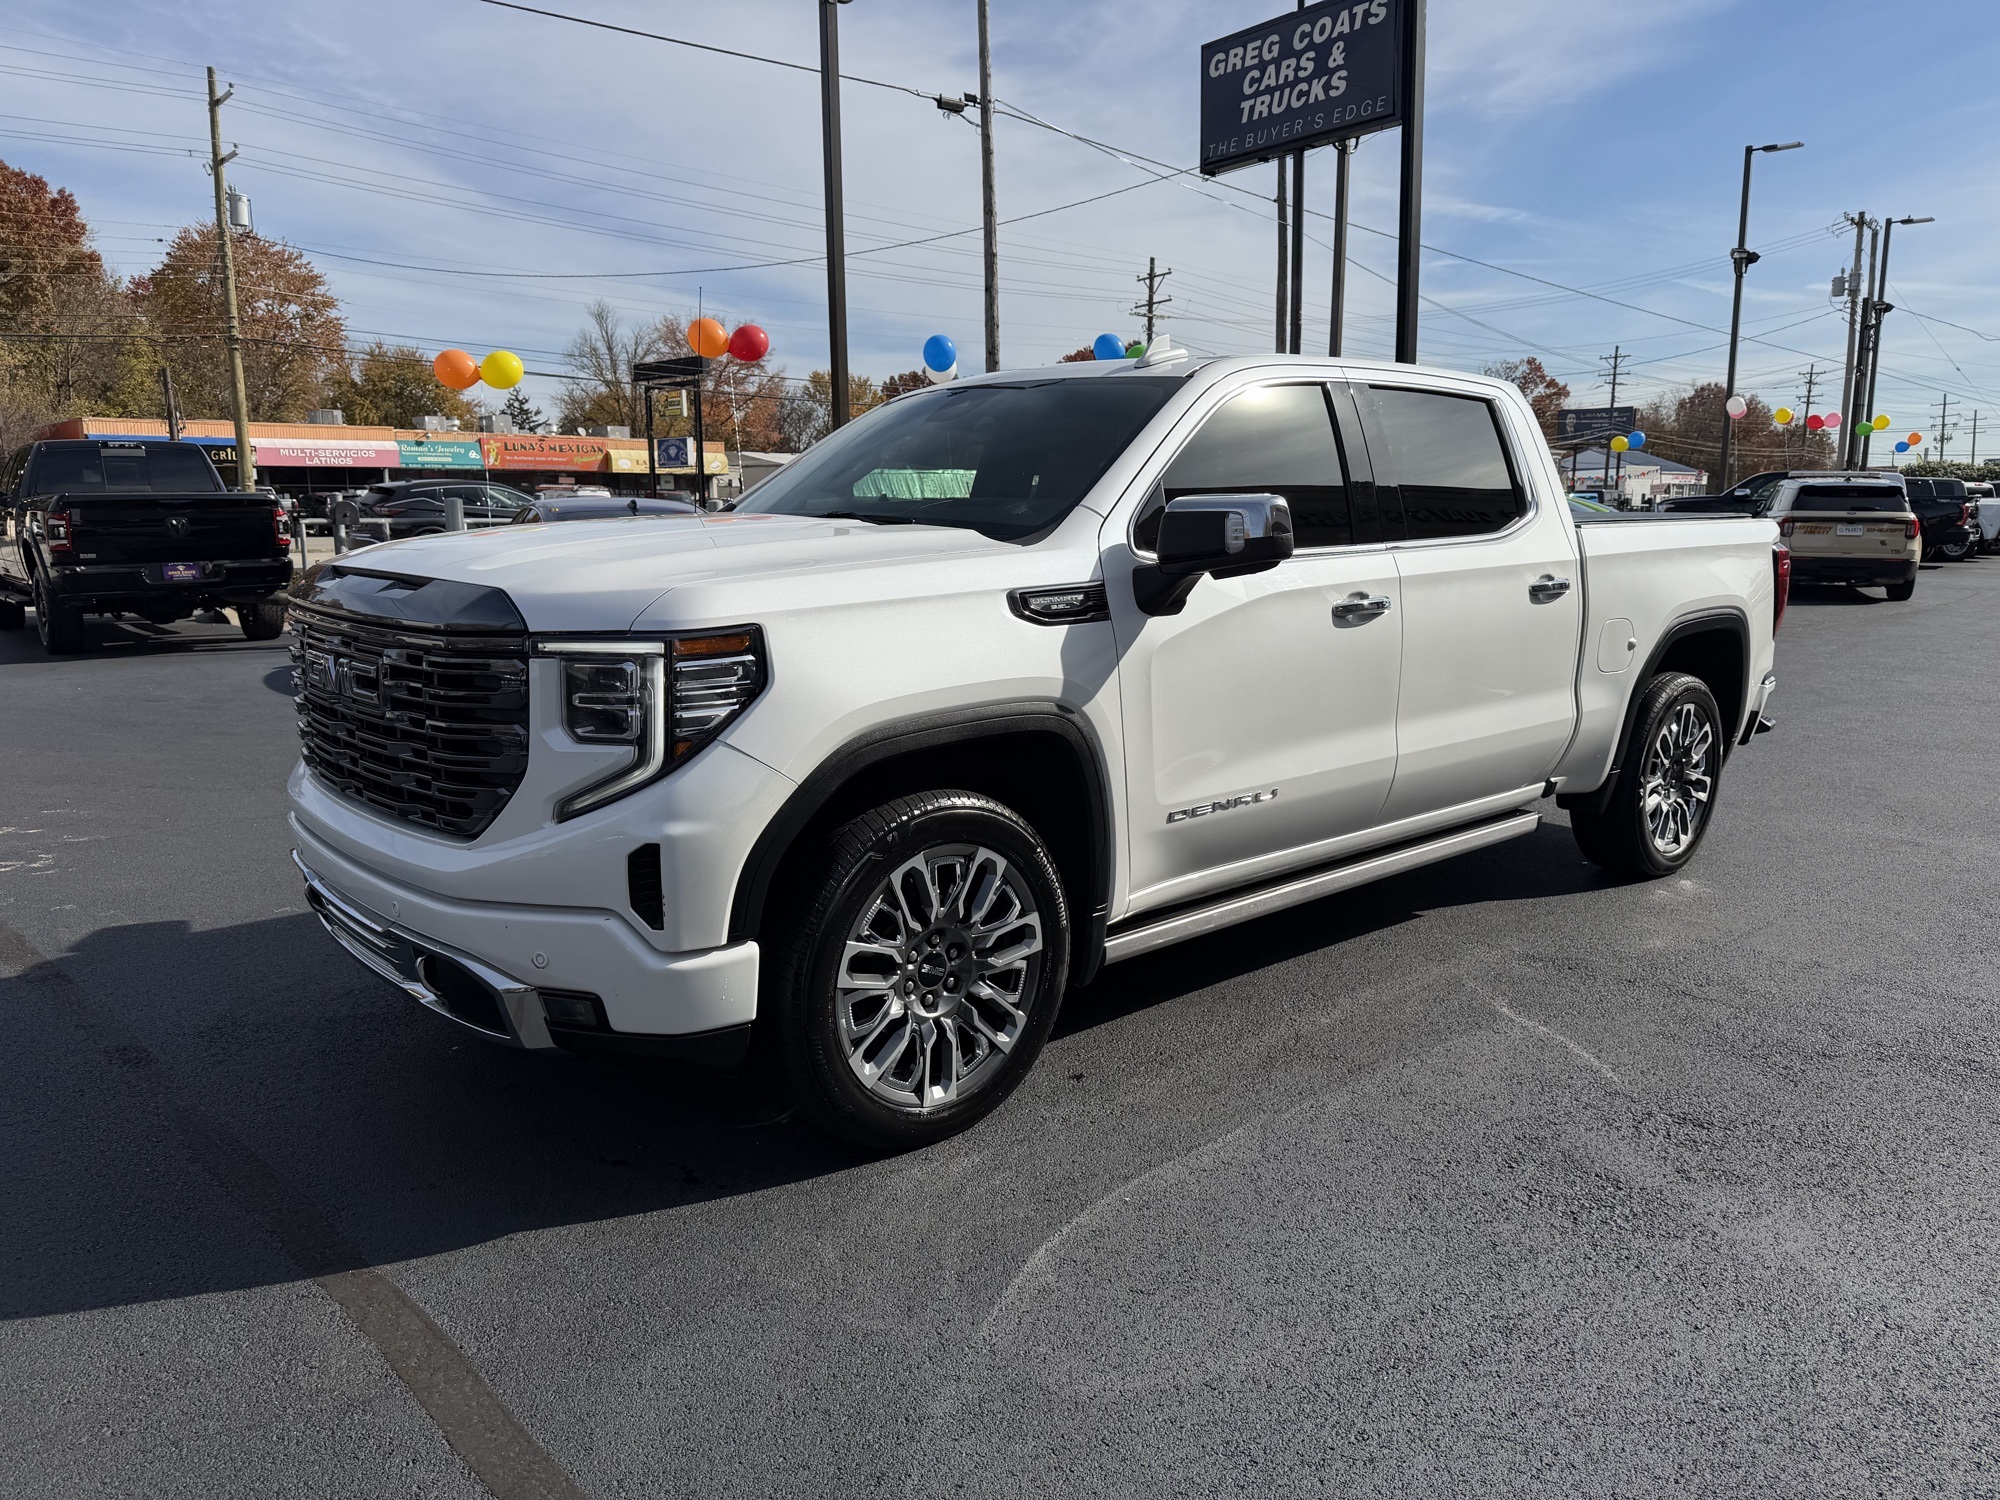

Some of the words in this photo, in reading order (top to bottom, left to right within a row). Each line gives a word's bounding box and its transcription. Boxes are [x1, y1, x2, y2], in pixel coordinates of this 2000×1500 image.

[1208, 34, 1280, 78] GREG
[1292, 0, 1388, 51] COATS
[1242, 50, 1316, 96] CARS
[1327, 40, 1346, 69] &
[1240, 69, 1348, 124] TRUCKS
[1208, 137, 1238, 158] THE
[1244, 113, 1324, 148] BUYER'S
[1332, 95, 1387, 124] EDGE
[211, 447, 238, 461] GRIL
[279, 448, 376, 458] MULTI-SERVICIOS
[305, 457, 354, 465] LATINOS
[503, 441, 545, 452] LUNA'S
[548, 443, 604, 454] MEXICAN
[1030, 594, 1084, 604] ULTIMATE
[305, 649, 378, 705] GMC
[1165, 786, 1279, 825] DENALI
[1034, 846, 1067, 928] BRIDGESTONE
[920, 963, 946, 977] GMC
